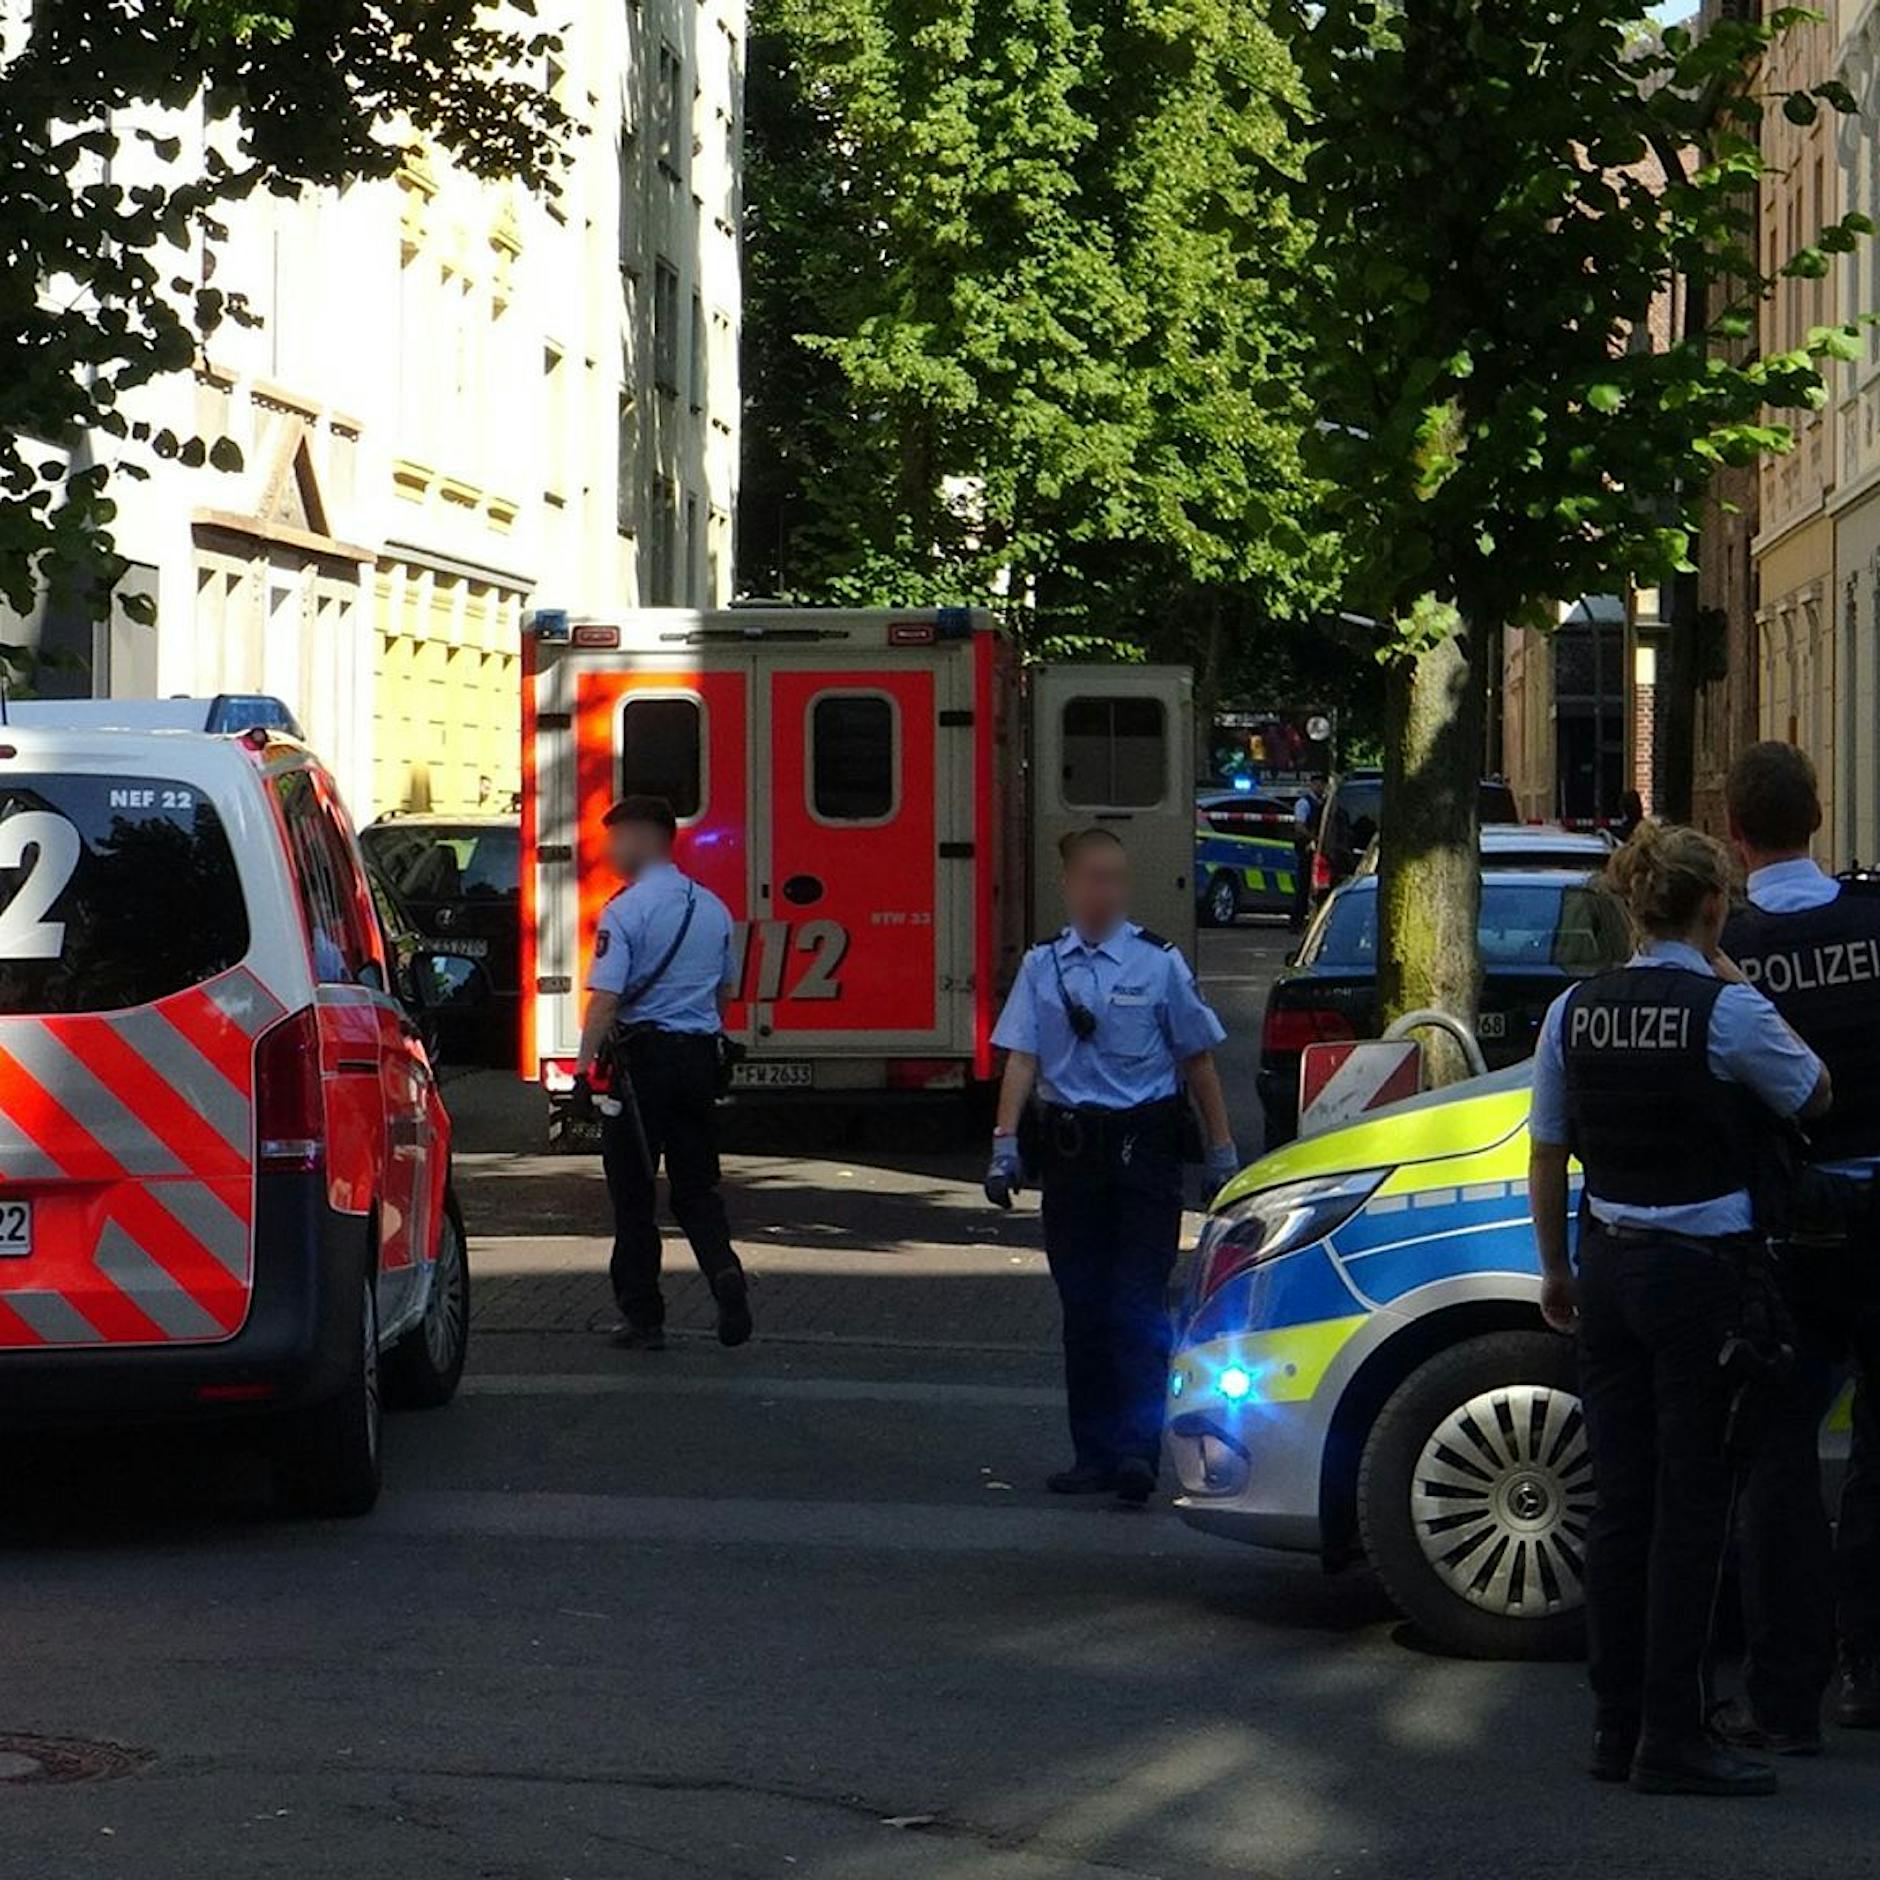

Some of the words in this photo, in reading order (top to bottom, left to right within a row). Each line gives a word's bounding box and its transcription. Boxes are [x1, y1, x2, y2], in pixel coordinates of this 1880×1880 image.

[109, 789, 154, 808] NEF
[161, 790, 192, 808] 22
[1739, 938, 1880, 994] POLIZEI
[1570, 1006, 1691, 1049] POLIZEI
[0, 1206, 26, 1241] 2
